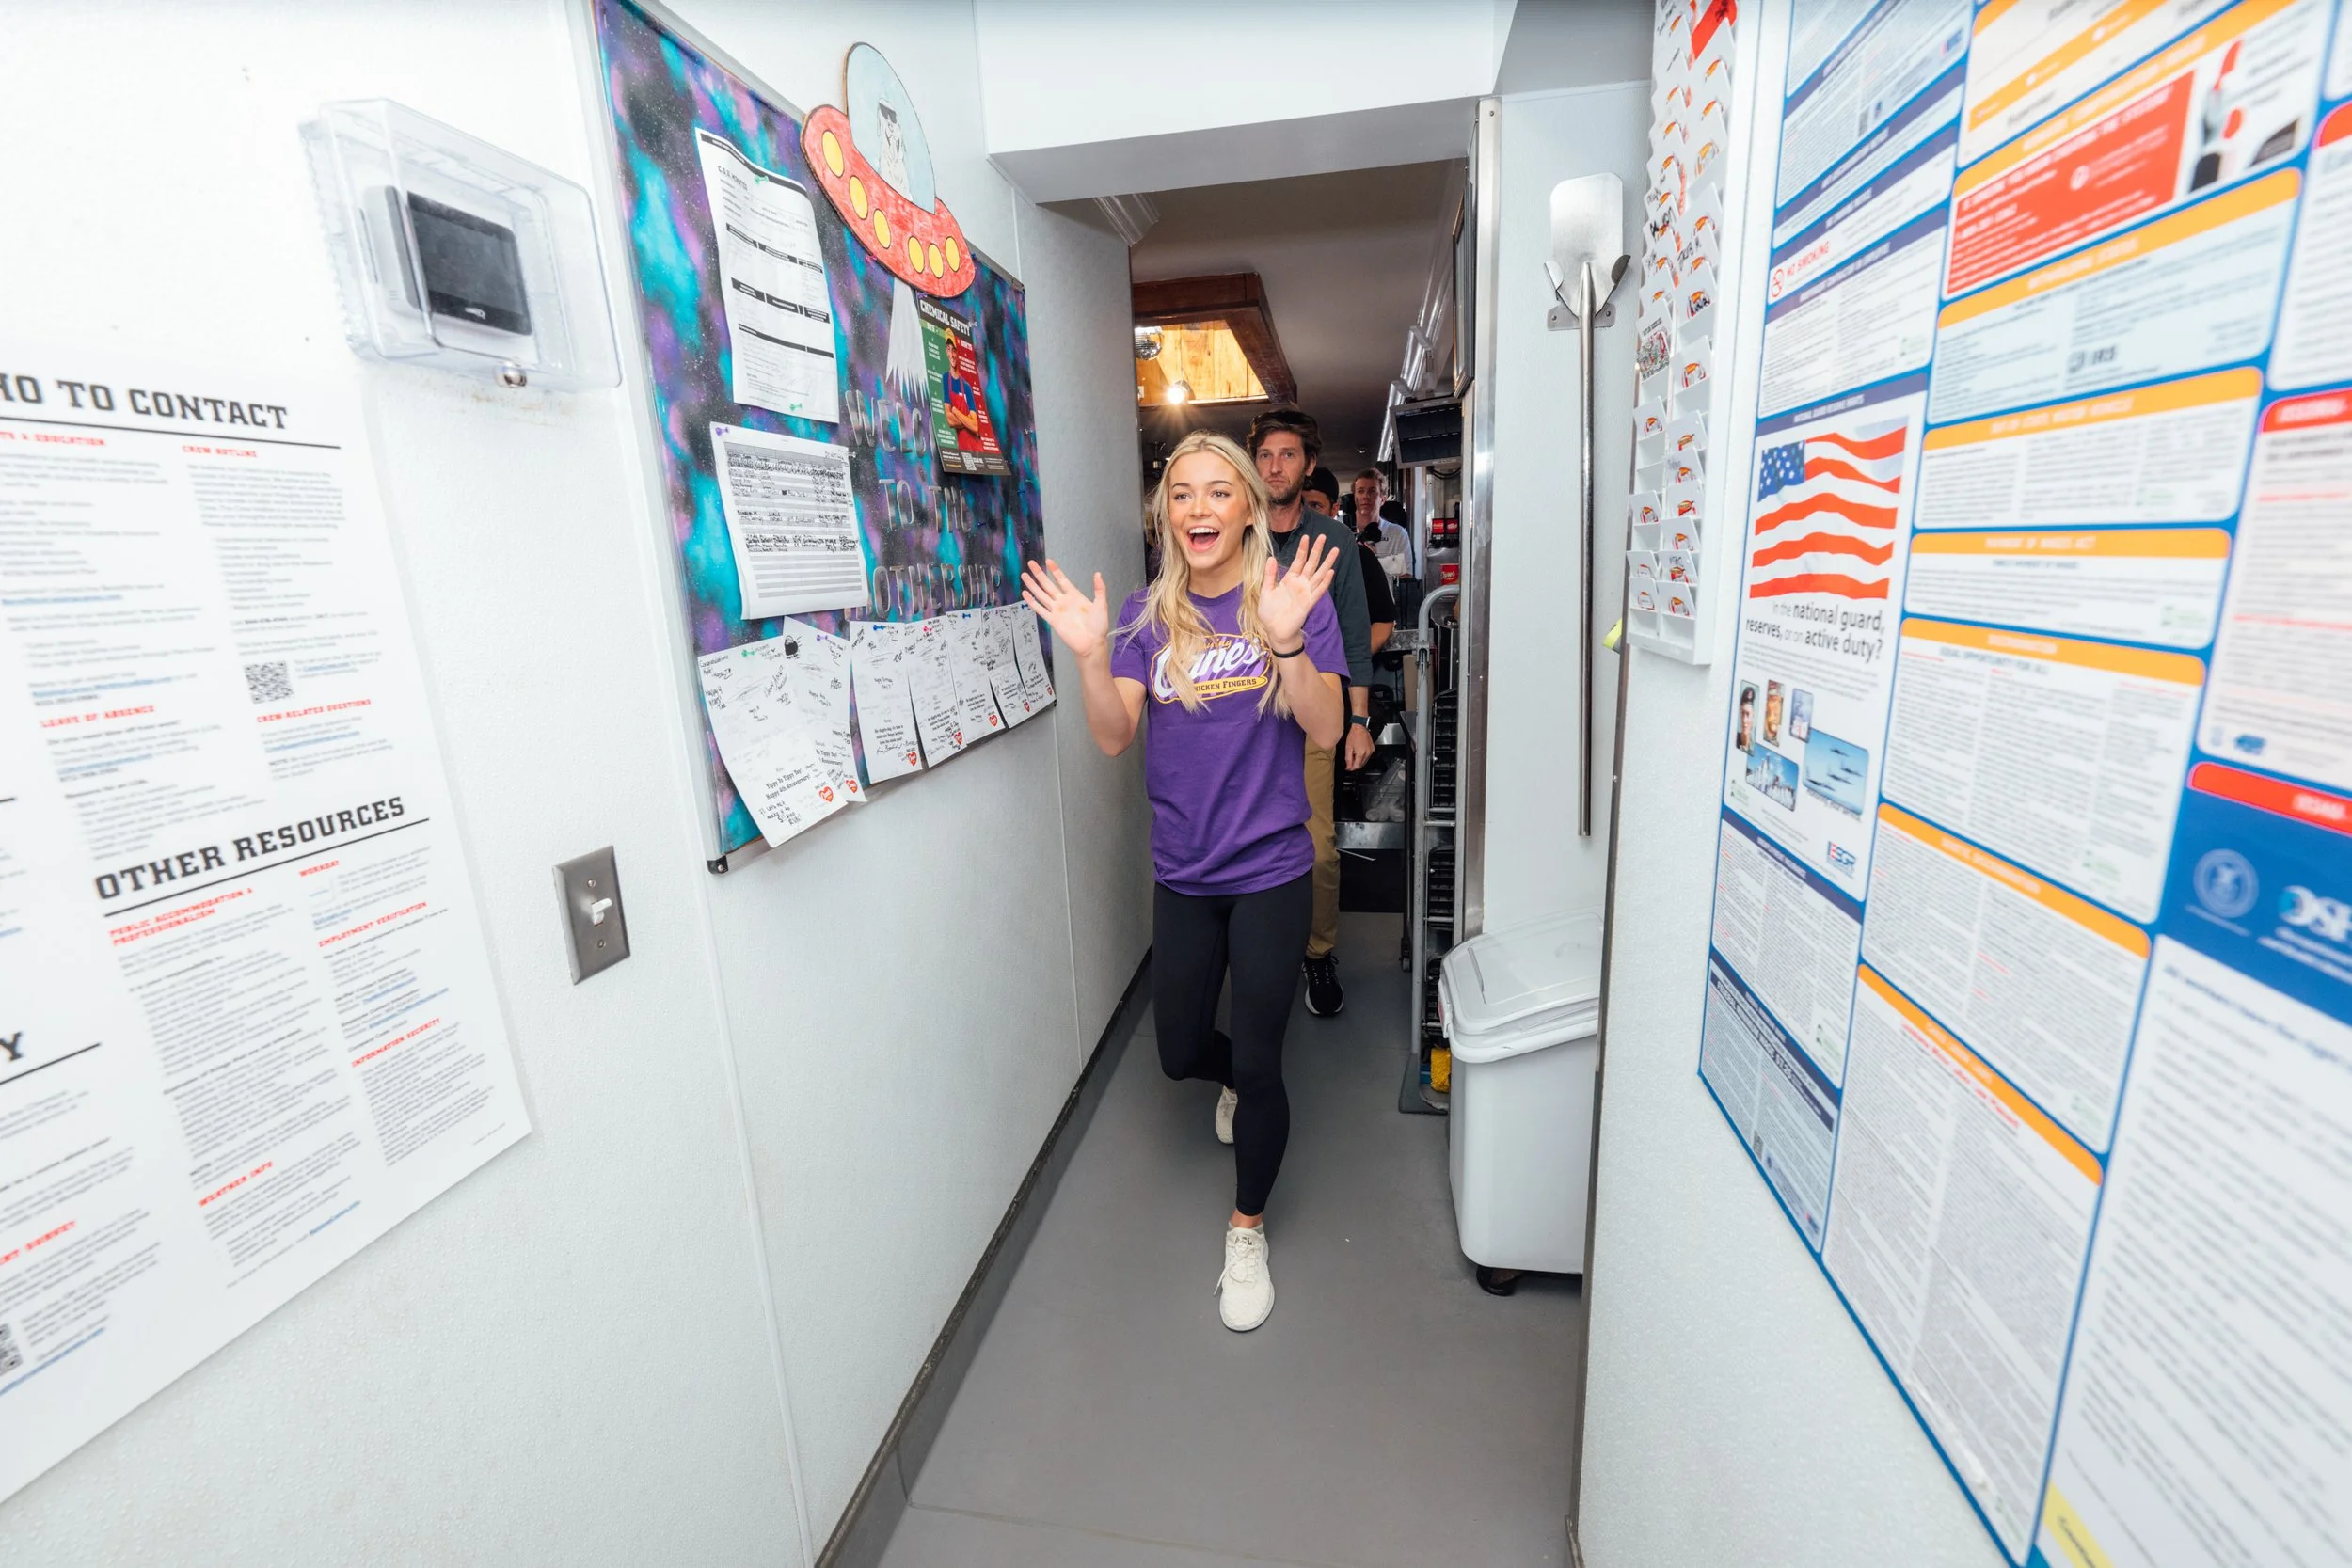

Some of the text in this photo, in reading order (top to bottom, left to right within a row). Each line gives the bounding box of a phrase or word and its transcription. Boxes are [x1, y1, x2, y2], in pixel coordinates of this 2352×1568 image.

[920, 299, 970, 336] CHEMICAL SAFETY
[56, 380, 115, 411] TO
[128, 388, 288, 430] CONTACT
[845, 389, 935, 458] WELC
[879, 478, 914, 531] TO
[844, 562, 1002, 621] OTHERSHIP
[1793, 603, 1838, 625] national
[1840, 610, 1884, 634] guard,
[1746, 619, 1783, 641] reserves,
[1805, 629, 1838, 651] active
[1842, 633, 1883, 664] duty?
[1195, 678, 1257, 692] HICKEN FINGERS
[286, 706, 324, 719] RELATED
[326, 699, 372, 712] QUESTIONS
[95, 796, 405, 900] OTHER RESOURCES
[318, 921, 374, 948] EMPLOYMENT
[1717, 980, 1737, 1011] FEDERAL
